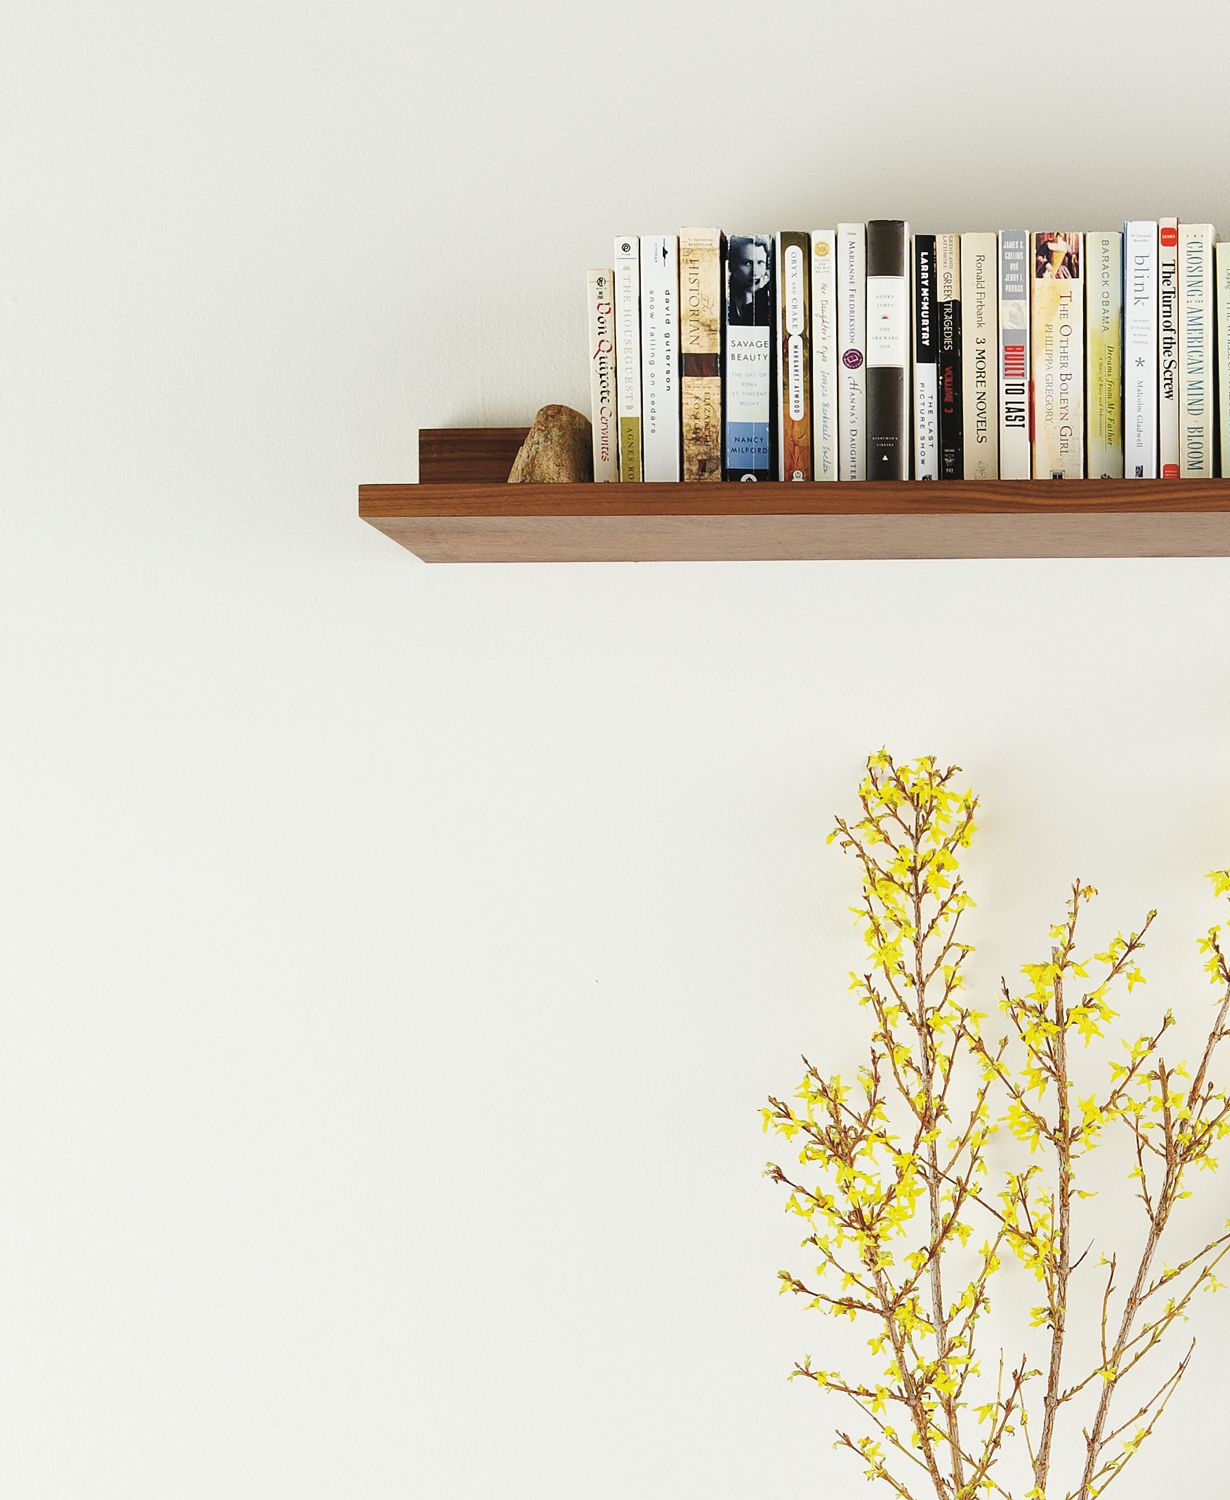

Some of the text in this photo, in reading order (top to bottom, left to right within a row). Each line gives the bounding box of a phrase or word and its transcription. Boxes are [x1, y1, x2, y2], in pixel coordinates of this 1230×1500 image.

[976, 255, 985, 289] Ronald
[1102, 240, 1110, 332] BARACK OBAMA
[1133, 254, 1149, 306] blink
[1186, 241, 1203, 296] CLOSING
[976, 292, 986, 328] Firbank
[1162, 260, 1177, 400] The Turn of the Screw
[593, 302, 613, 404] Don Quixote
[648, 326, 657, 365] falling
[663, 289, 672, 391] david guterson
[731, 340, 769, 348] SAVAGE
[731, 353, 768, 362] BEAUTY
[1186, 307, 1204, 416] AMERICAN MIND
[650, 372, 656, 386] on
[976, 349, 986, 388] MORE
[1005, 345, 1025, 428] BUILT TO LAST
[1060, 291, 1072, 456] THE OTHER BOLEYN GIRL
[976, 391, 987, 443] NOVELS
[1105, 345, 1115, 446] Dreams from My Father
[1136, 381, 1144, 447] Malcolm Gladwell
[599, 406, 610, 462] Cervantes
[731, 446, 768, 454] MILFORD
[734, 436, 764, 445] NANCY
[1187, 426, 1204, 471] BLOOM
